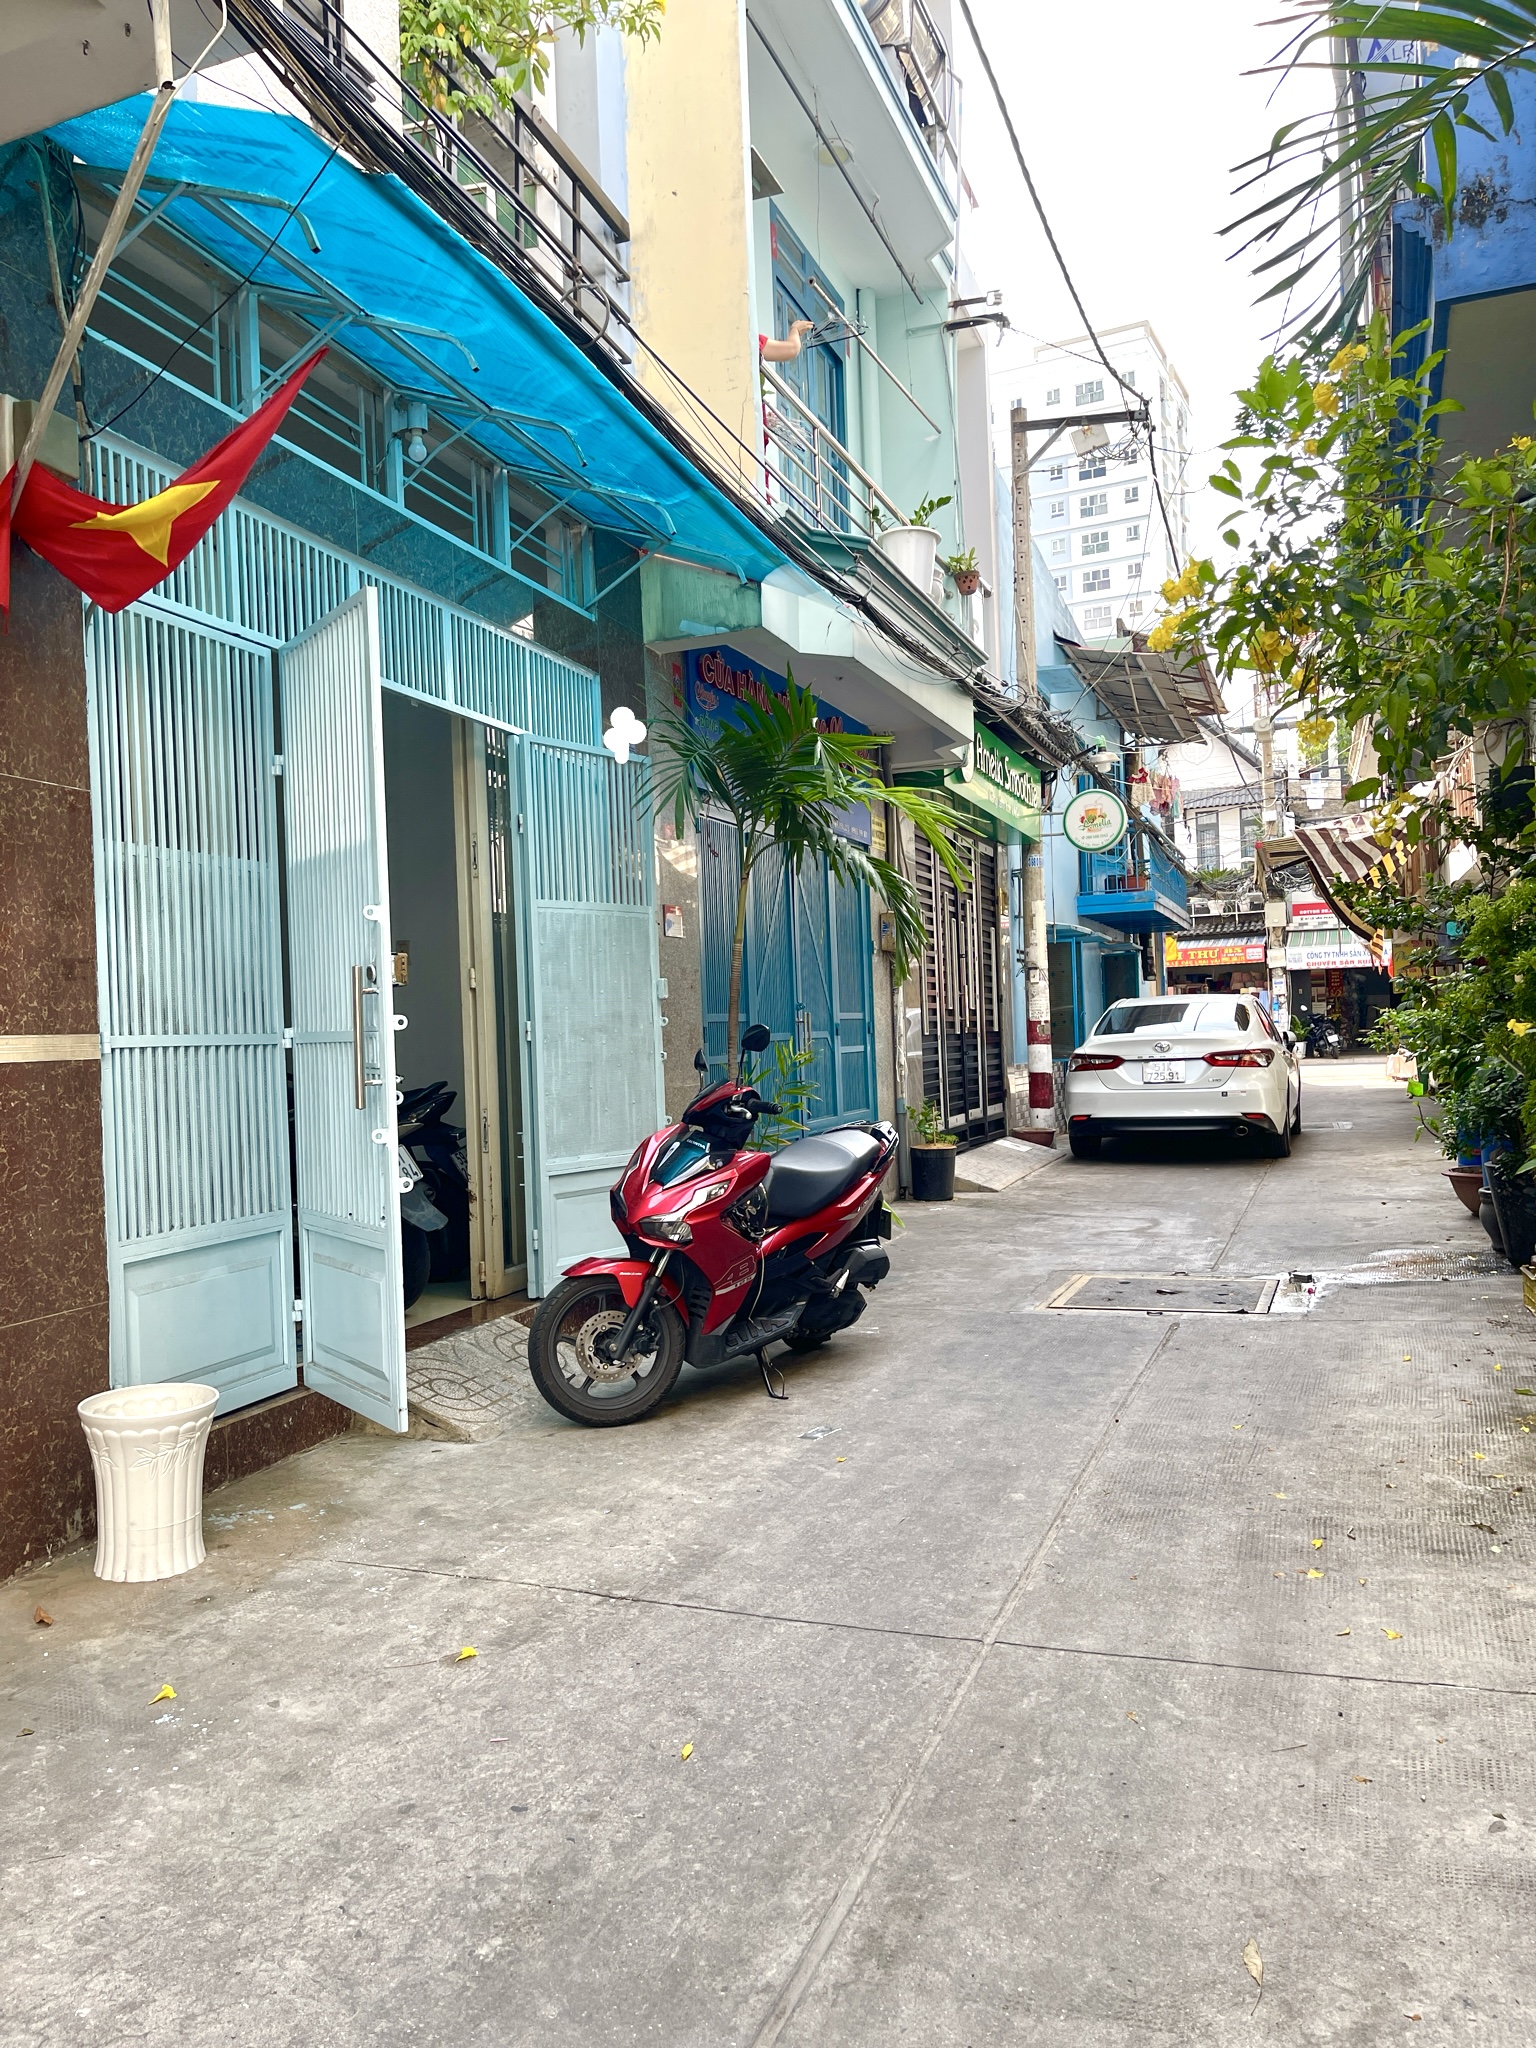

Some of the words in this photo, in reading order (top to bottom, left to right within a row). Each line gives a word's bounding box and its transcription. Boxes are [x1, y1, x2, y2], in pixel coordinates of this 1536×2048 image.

[702, 650, 735, 696] CỬA
[976, 732, 1004, 787] Amelia
[1306, 950, 1322, 959] CÔNG
[1147, 1072, 1180, 1081] 725.91
